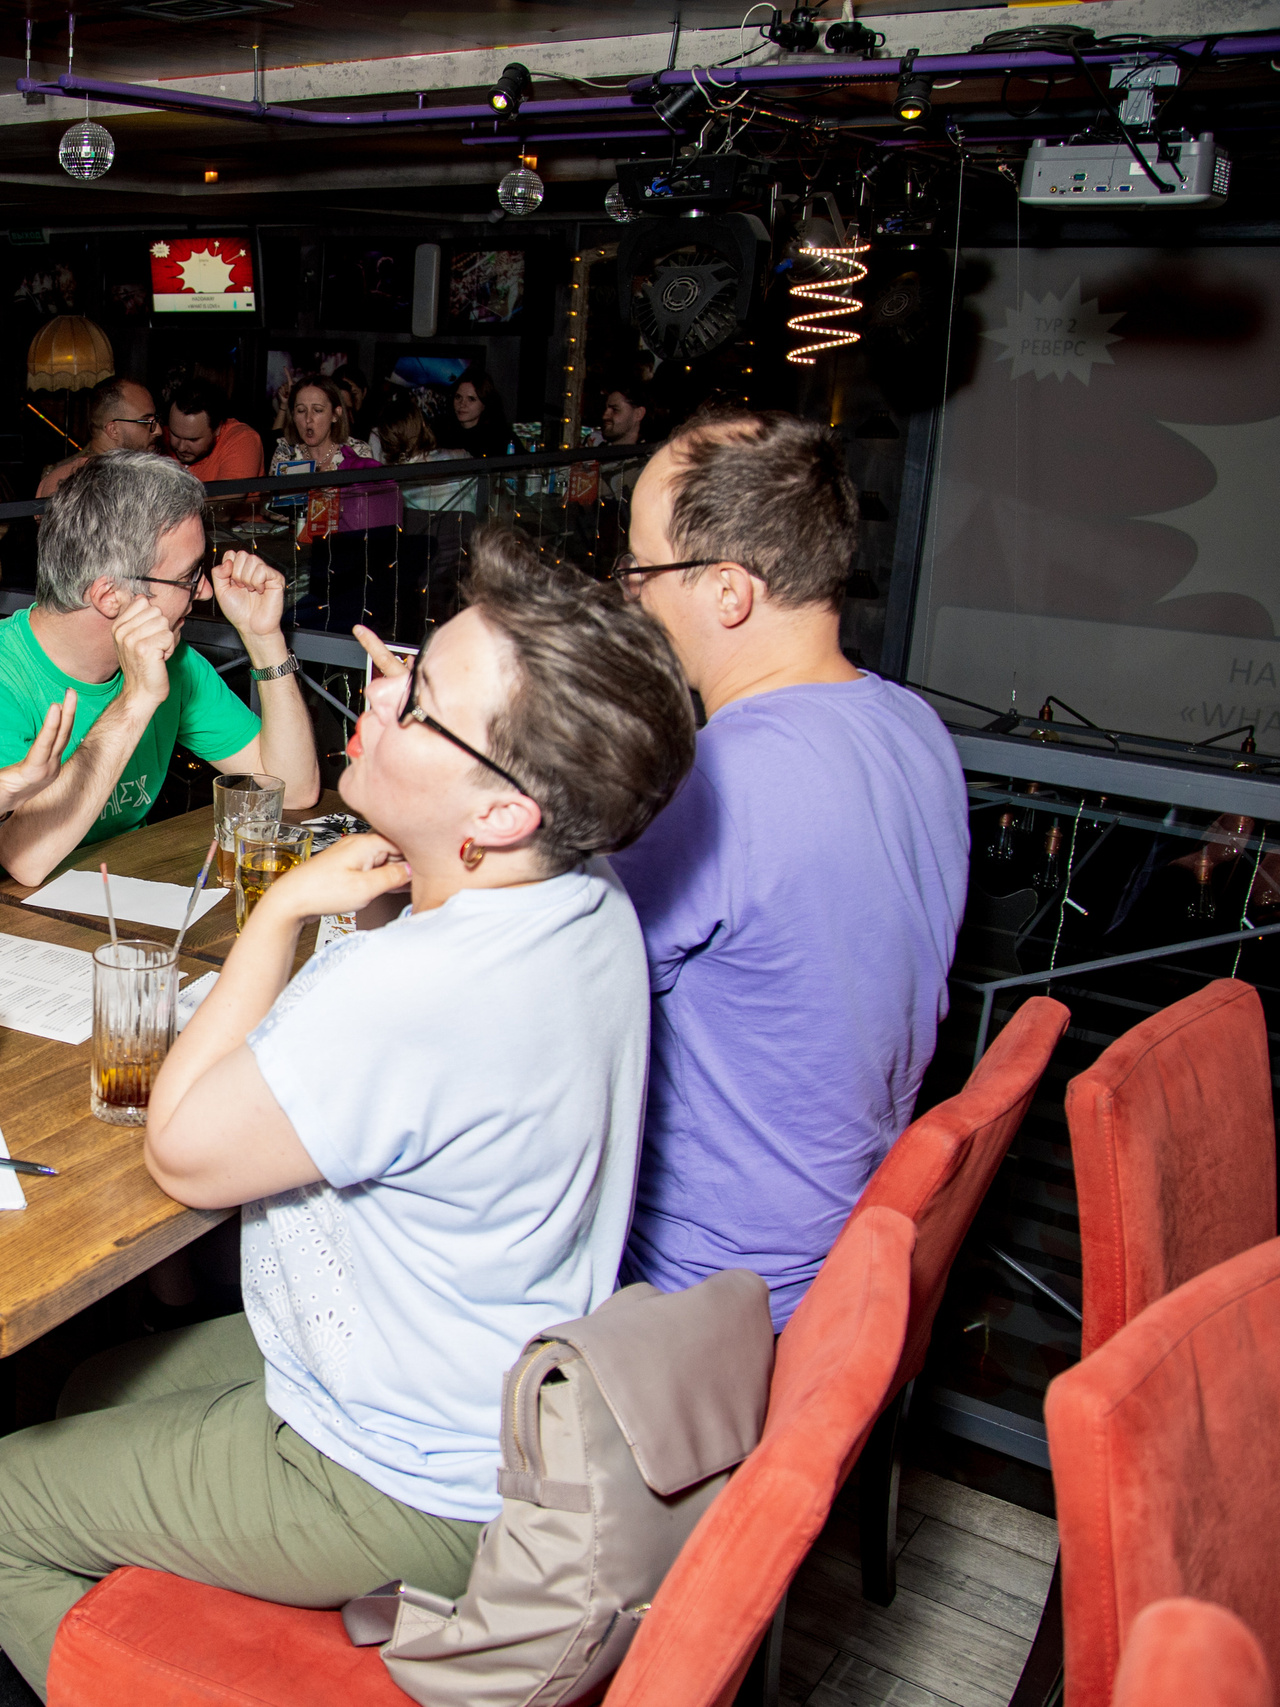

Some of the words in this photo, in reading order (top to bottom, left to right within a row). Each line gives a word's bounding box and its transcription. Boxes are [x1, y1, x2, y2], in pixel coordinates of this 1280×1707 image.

[11, 231, 42, 240] ВЫХОД
[1035, 317, 1063, 333] ТУР
[1067, 317, 1077, 333] 2
[1020, 338, 1087, 357] РЕВЕРС
